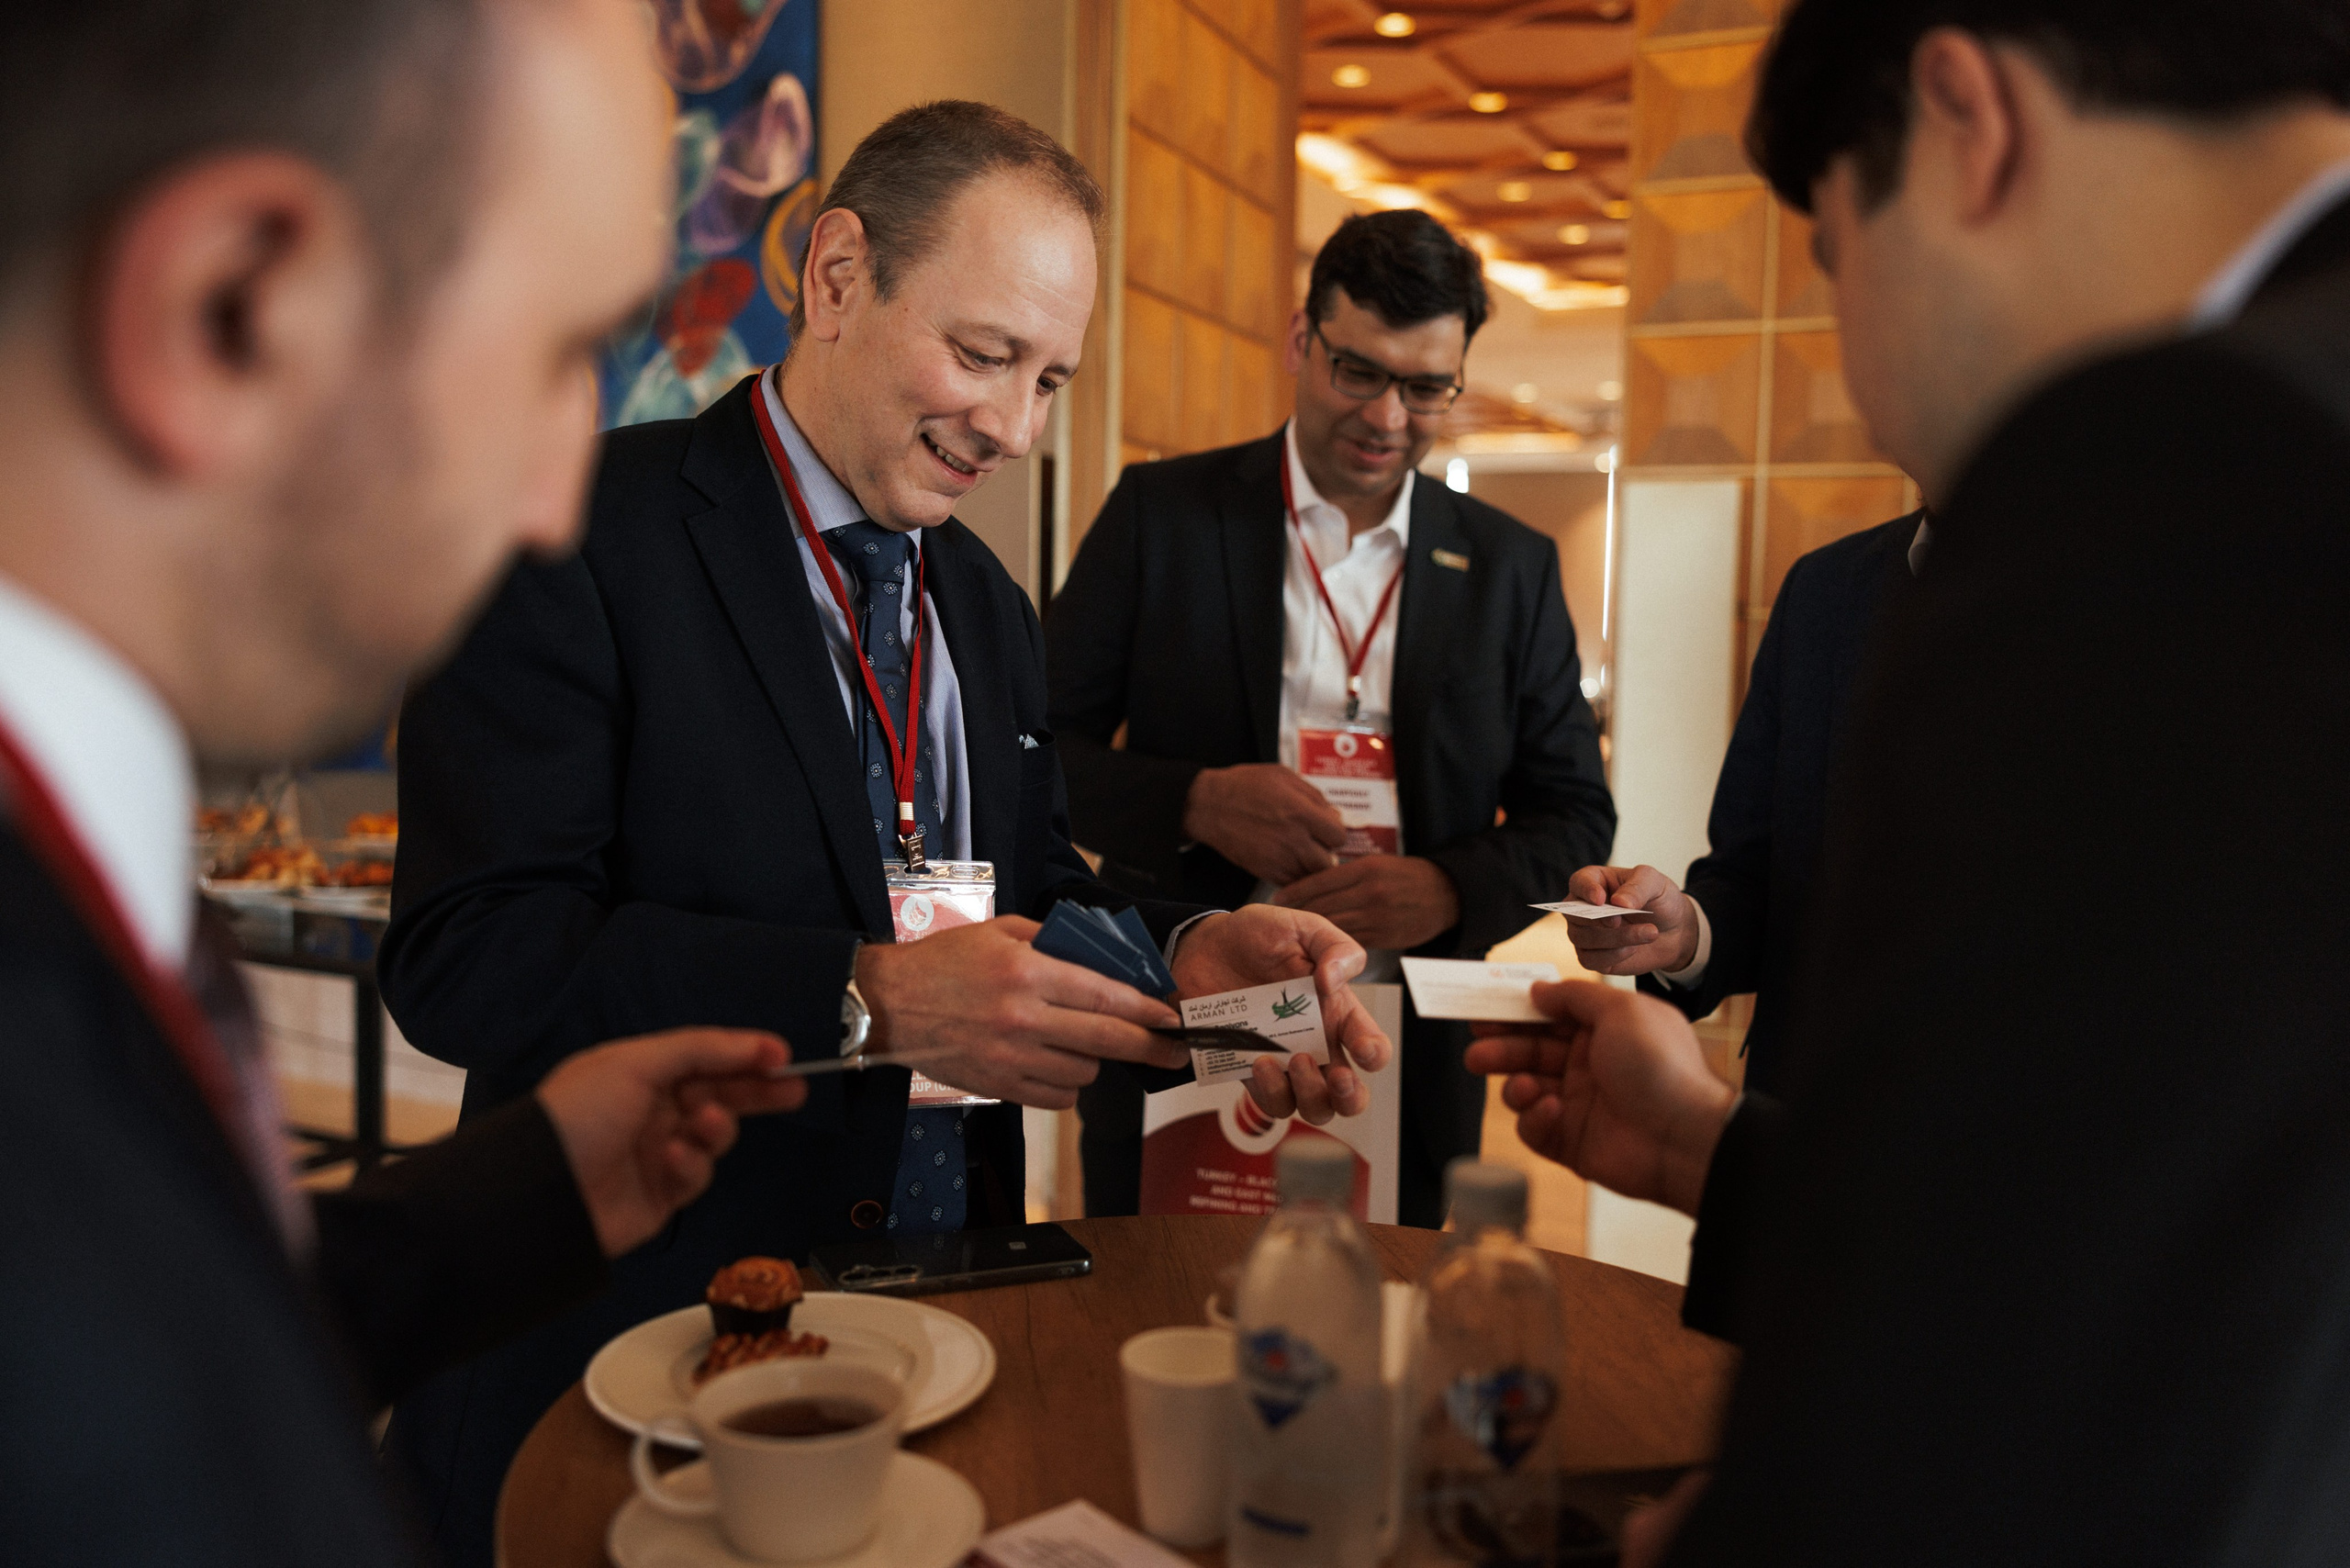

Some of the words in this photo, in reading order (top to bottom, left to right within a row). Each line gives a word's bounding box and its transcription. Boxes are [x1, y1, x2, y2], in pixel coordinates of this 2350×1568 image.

[1191, 1009, 1225, 1022] ARMAN
[1230, 1004, 1248, 1014] LTD
[1196, 1168, 1237, 1182] TURKEY
